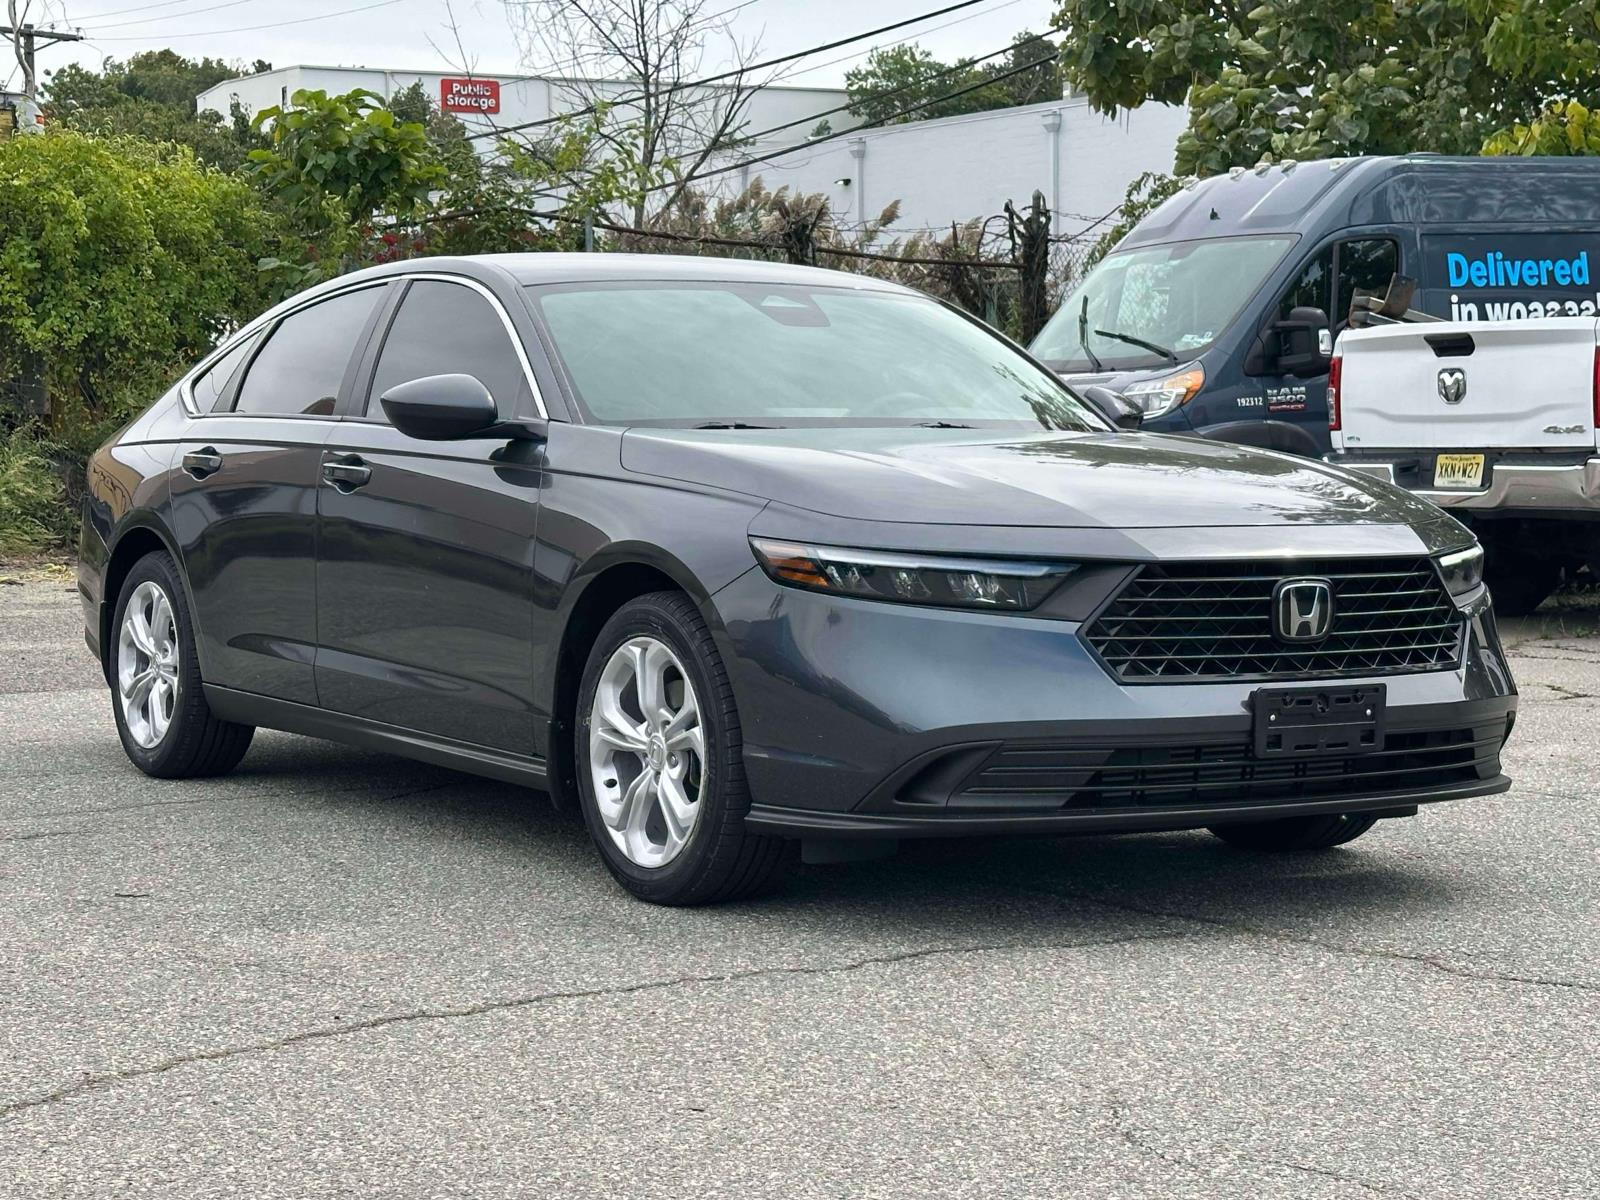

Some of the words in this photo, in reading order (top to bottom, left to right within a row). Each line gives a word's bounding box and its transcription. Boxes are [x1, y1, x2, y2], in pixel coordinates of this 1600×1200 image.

[452, 83, 491, 96] Public
[446, 94, 496, 110] Storage
[1447, 251, 1590, 287] Delivered
[1450, 294, 1479, 321] in
[1236, 396, 1263, 407] 192312
